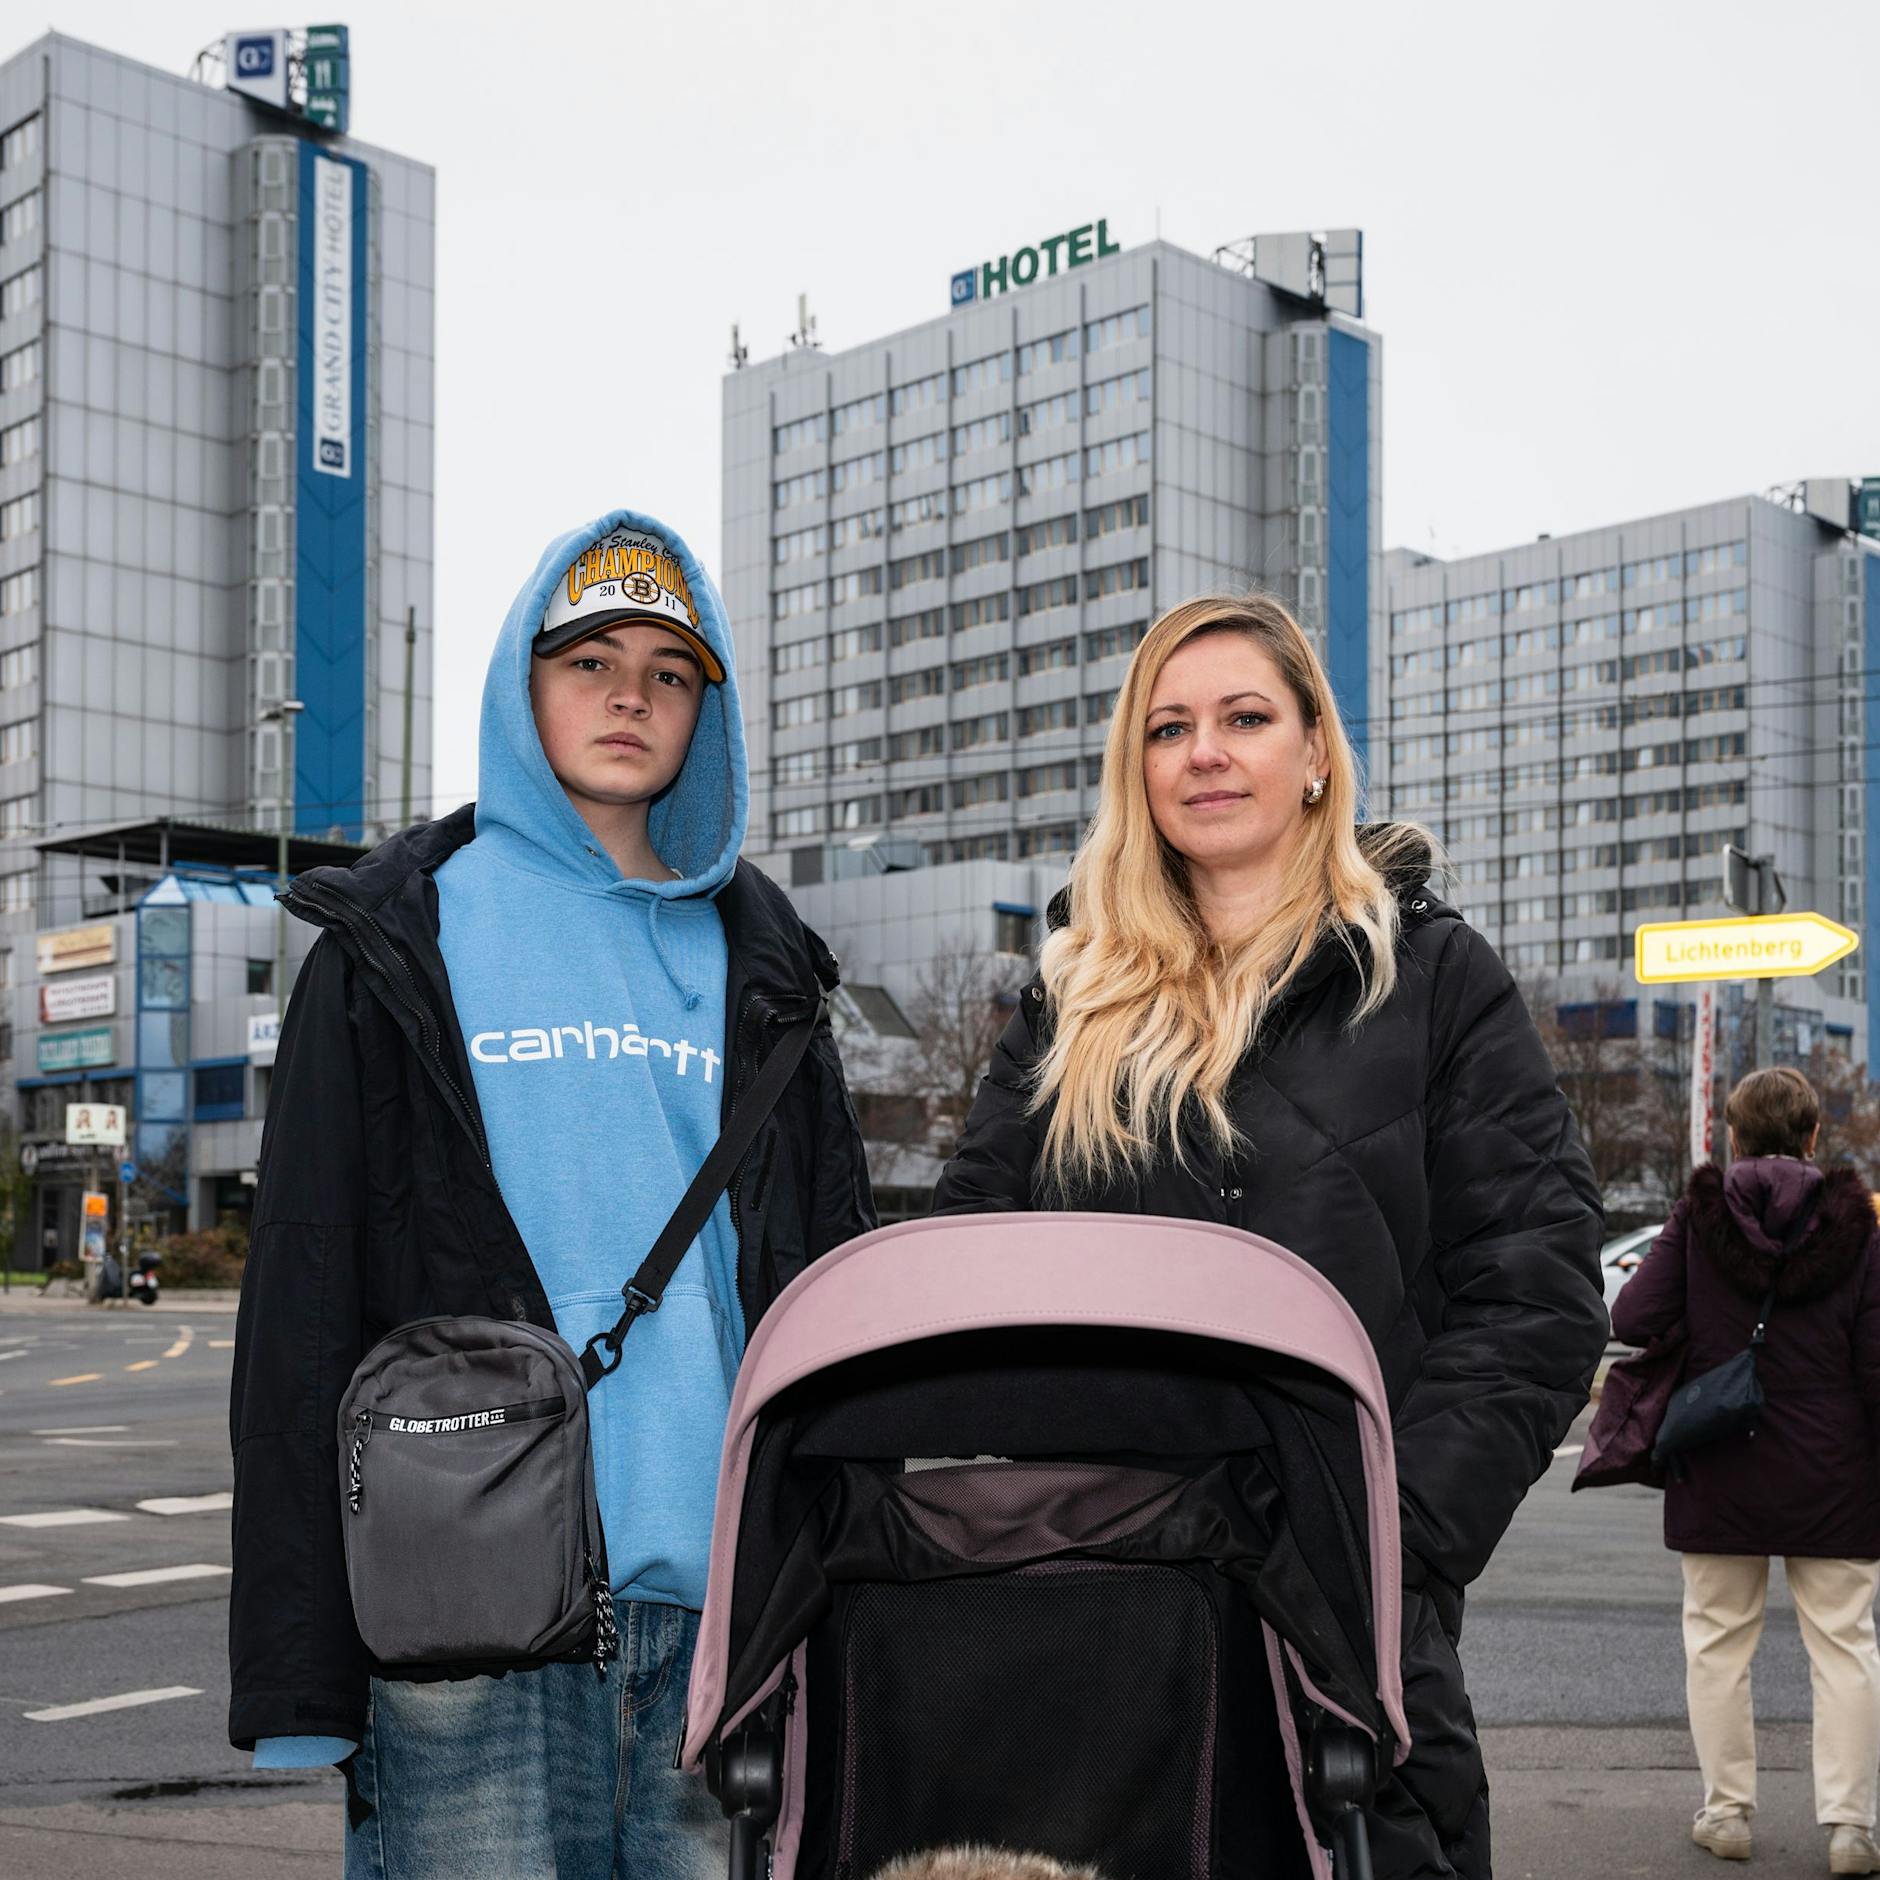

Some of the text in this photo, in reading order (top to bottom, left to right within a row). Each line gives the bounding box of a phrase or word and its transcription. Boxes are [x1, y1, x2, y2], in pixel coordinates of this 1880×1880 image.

[324, 169, 345, 255] HOTEL
[983, 218, 1119, 299] HOTEL
[323, 262, 343, 326] CITY
[324, 332, 344, 431] GRAND
[609, 535, 659, 554] Stanley
[599, 585, 676, 611] 20 11
[1665, 938, 1803, 963] Lichtenberg
[470, 1021, 721, 1084] carhartt
[389, 1411, 490, 1433] GLOBETROTTER
